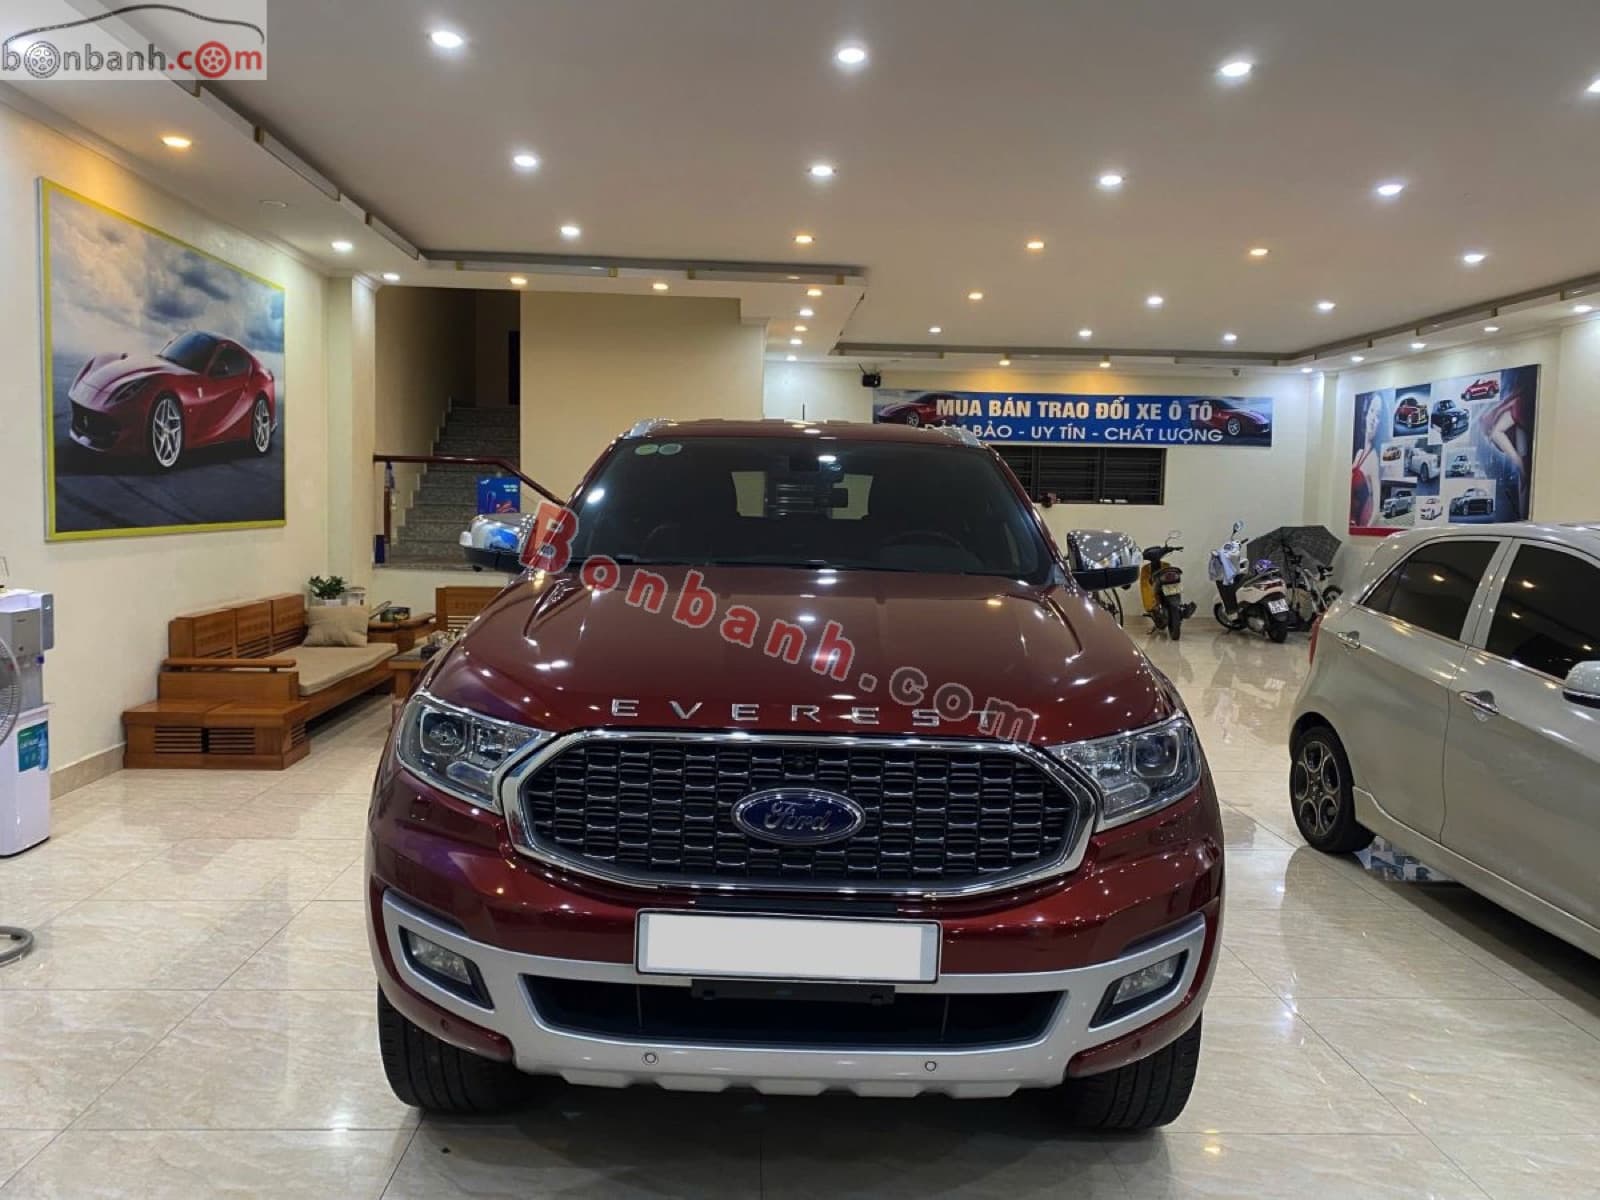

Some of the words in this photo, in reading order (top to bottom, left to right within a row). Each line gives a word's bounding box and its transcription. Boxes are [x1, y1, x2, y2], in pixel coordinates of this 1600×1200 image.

[936, 399, 982, 417] MUA
[988, 397, 1032, 417] BÁN
[1037, 400, 1090, 419] TRAO
[1095, 396, 1131, 420] ĐỔI
[1136, 403, 1162, 421] XE
[1168, 401, 1182, 421] Ô
[1188, 401, 1213, 421] TÔ
[973, 420, 1013, 438] BẢO
[1031, 426, 1055, 439] UY
[1060, 423, 1086, 440] TÍN
[1104, 423, 1154, 441] CHẤT
[1159, 427, 1224, 444] LƯỢNG
[764, 800, 835, 831] Ford
